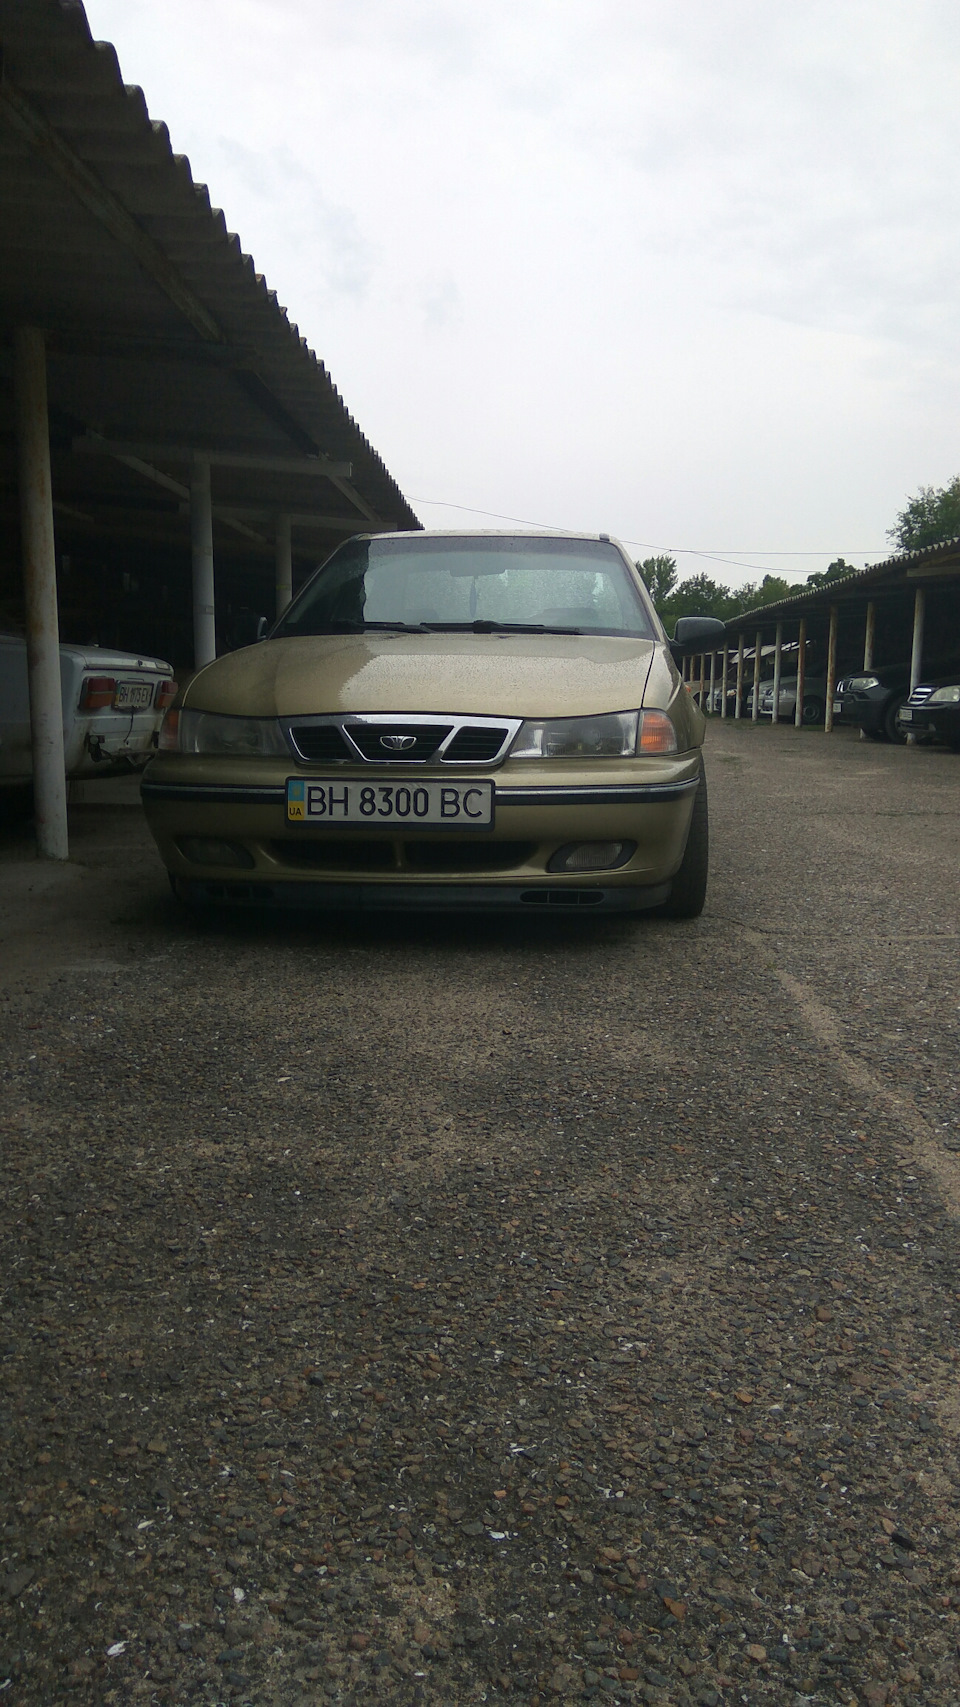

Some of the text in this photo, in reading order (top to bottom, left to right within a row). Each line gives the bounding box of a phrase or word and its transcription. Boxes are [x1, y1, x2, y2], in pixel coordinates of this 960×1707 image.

[289, 807, 302, 816] UA
[307, 786, 483, 818] BH 8300 BC
